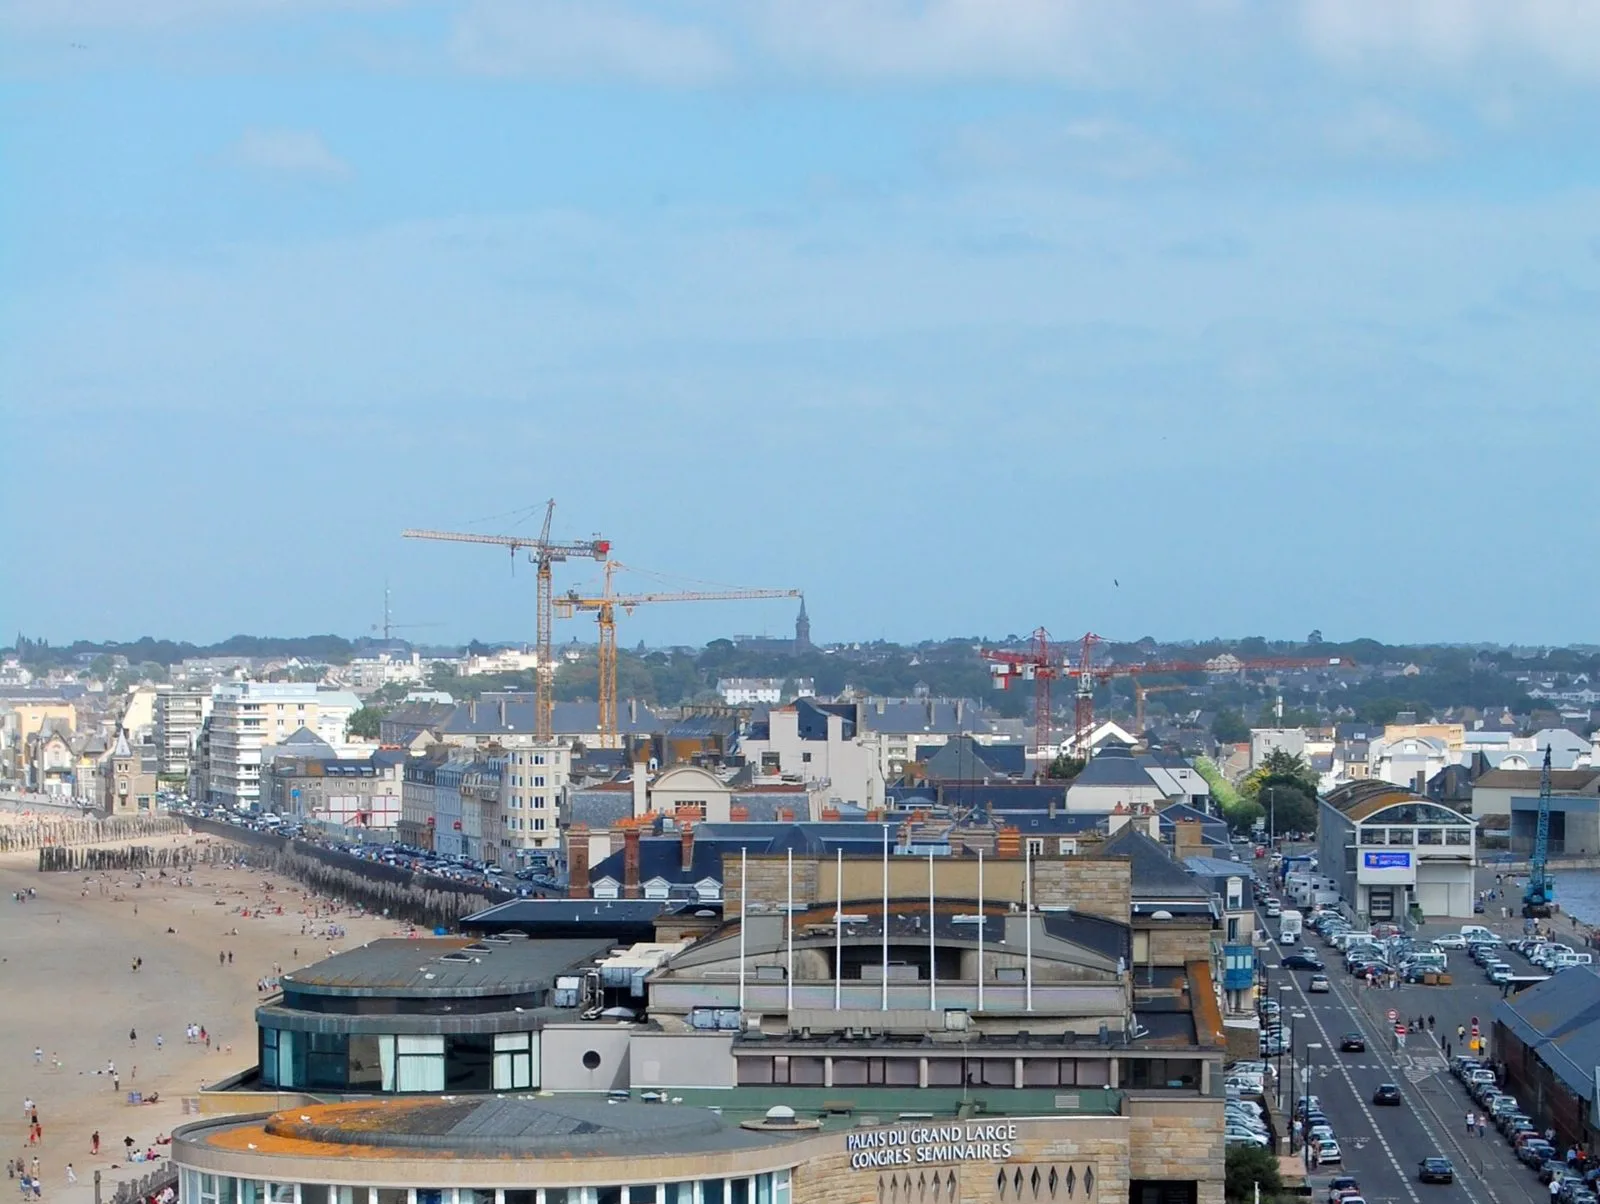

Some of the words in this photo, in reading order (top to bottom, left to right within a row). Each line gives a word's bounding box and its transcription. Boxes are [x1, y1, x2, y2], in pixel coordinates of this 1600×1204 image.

[847, 1131, 886, 1150] PALAIS
[889, 1130, 907, 1146] DU
[911, 1127, 961, 1144] GRAND
[966, 1125, 1017, 1141] LARGE
[851, 1147, 911, 1169] CONGRES
[916, 1143, 1012, 1163] SEMINAIRES
